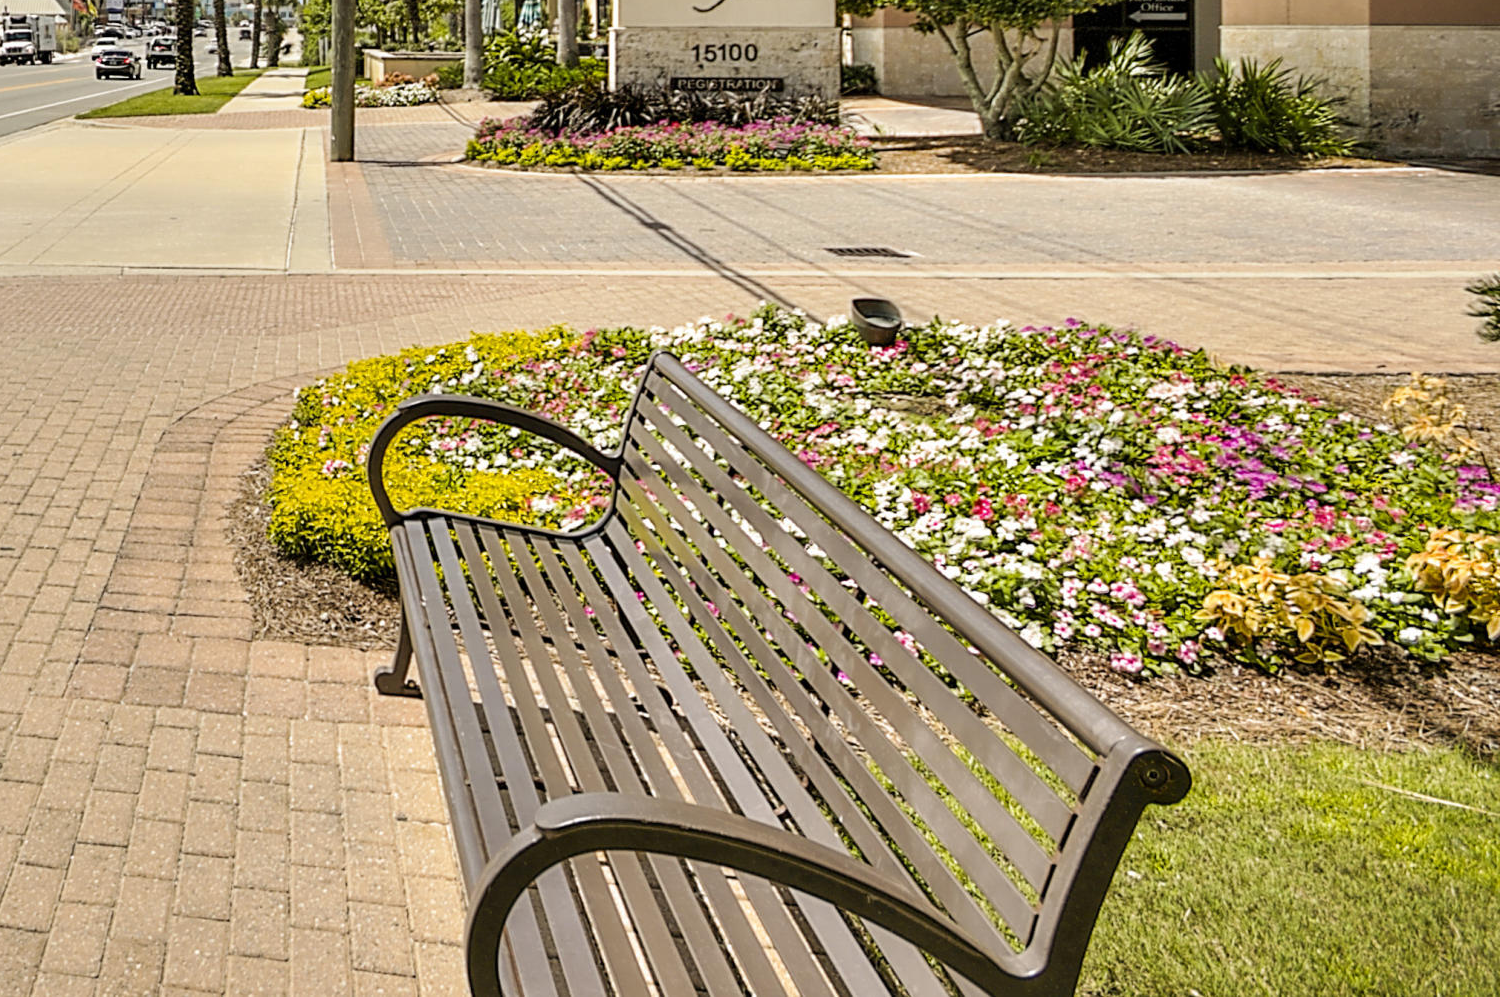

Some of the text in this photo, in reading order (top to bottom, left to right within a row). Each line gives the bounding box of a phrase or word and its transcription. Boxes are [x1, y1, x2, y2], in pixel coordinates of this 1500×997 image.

[1140, 2, 1174, 12] Office
[690, 43, 759, 62] 15100
[677, 78, 778, 90] REGISTRATION
